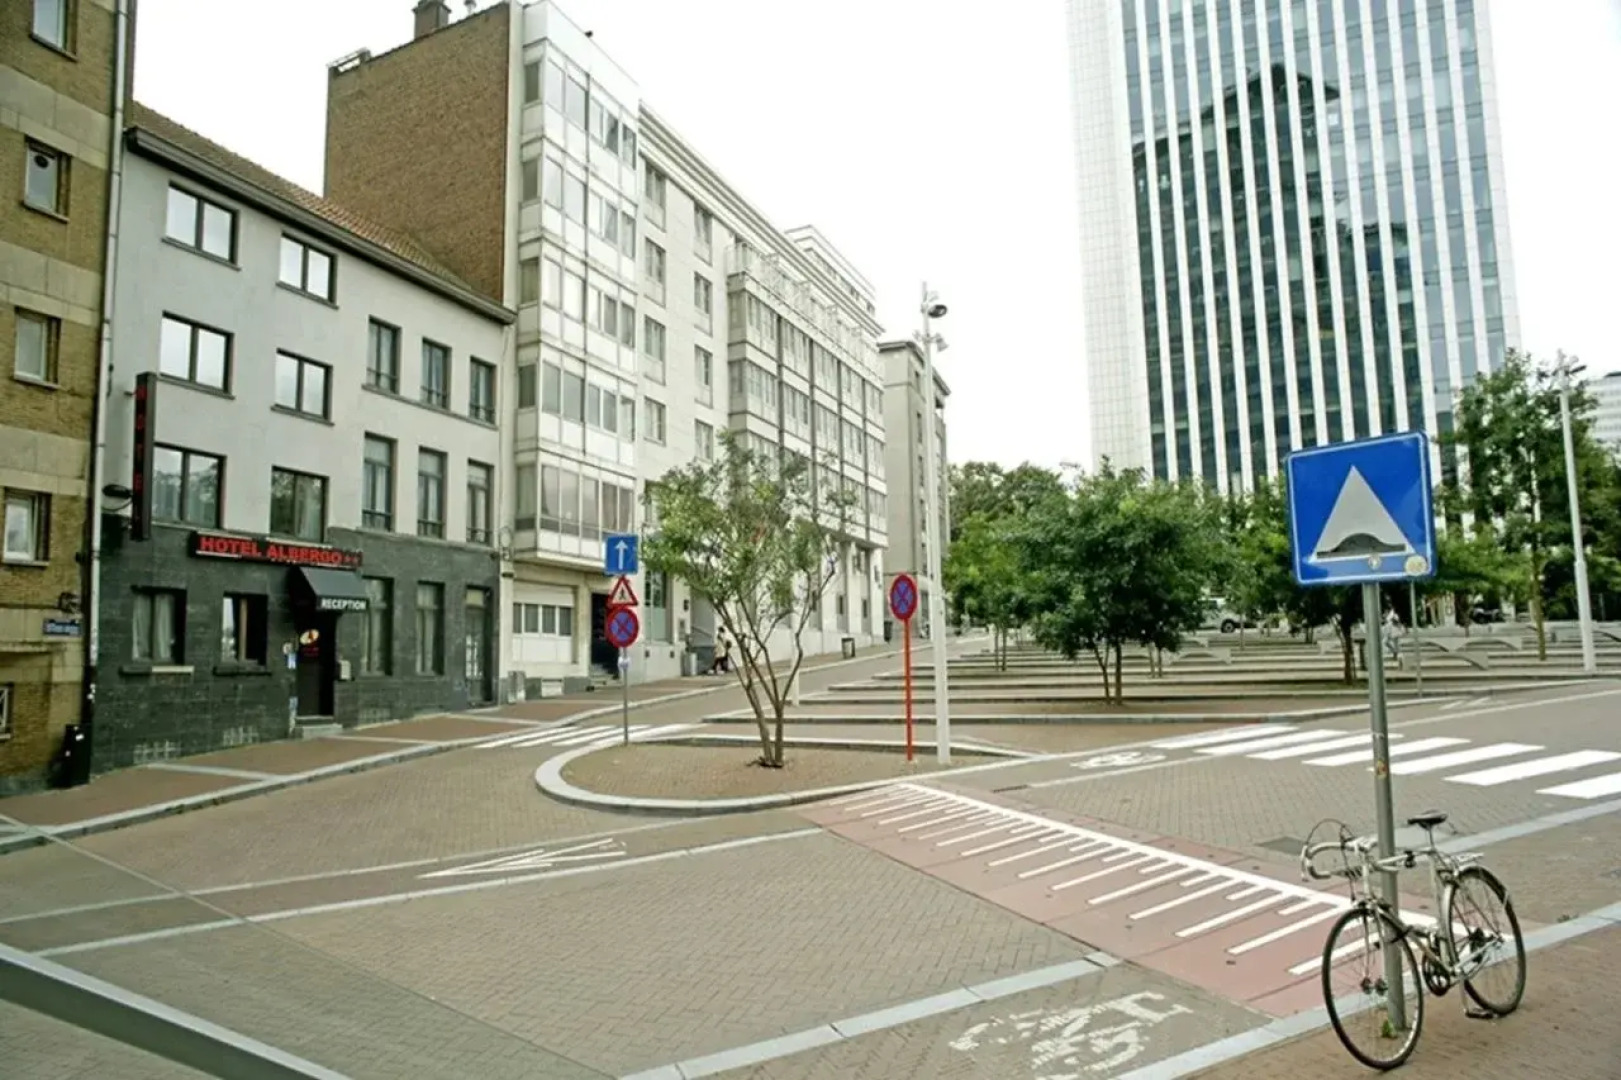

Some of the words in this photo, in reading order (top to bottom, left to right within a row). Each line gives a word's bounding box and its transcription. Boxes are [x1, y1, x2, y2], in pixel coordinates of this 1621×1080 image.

[200, 536, 262, 558] HOTEL
[266, 544, 342, 565] ALBERGO
[321, 598, 367, 610] RECEPTION
